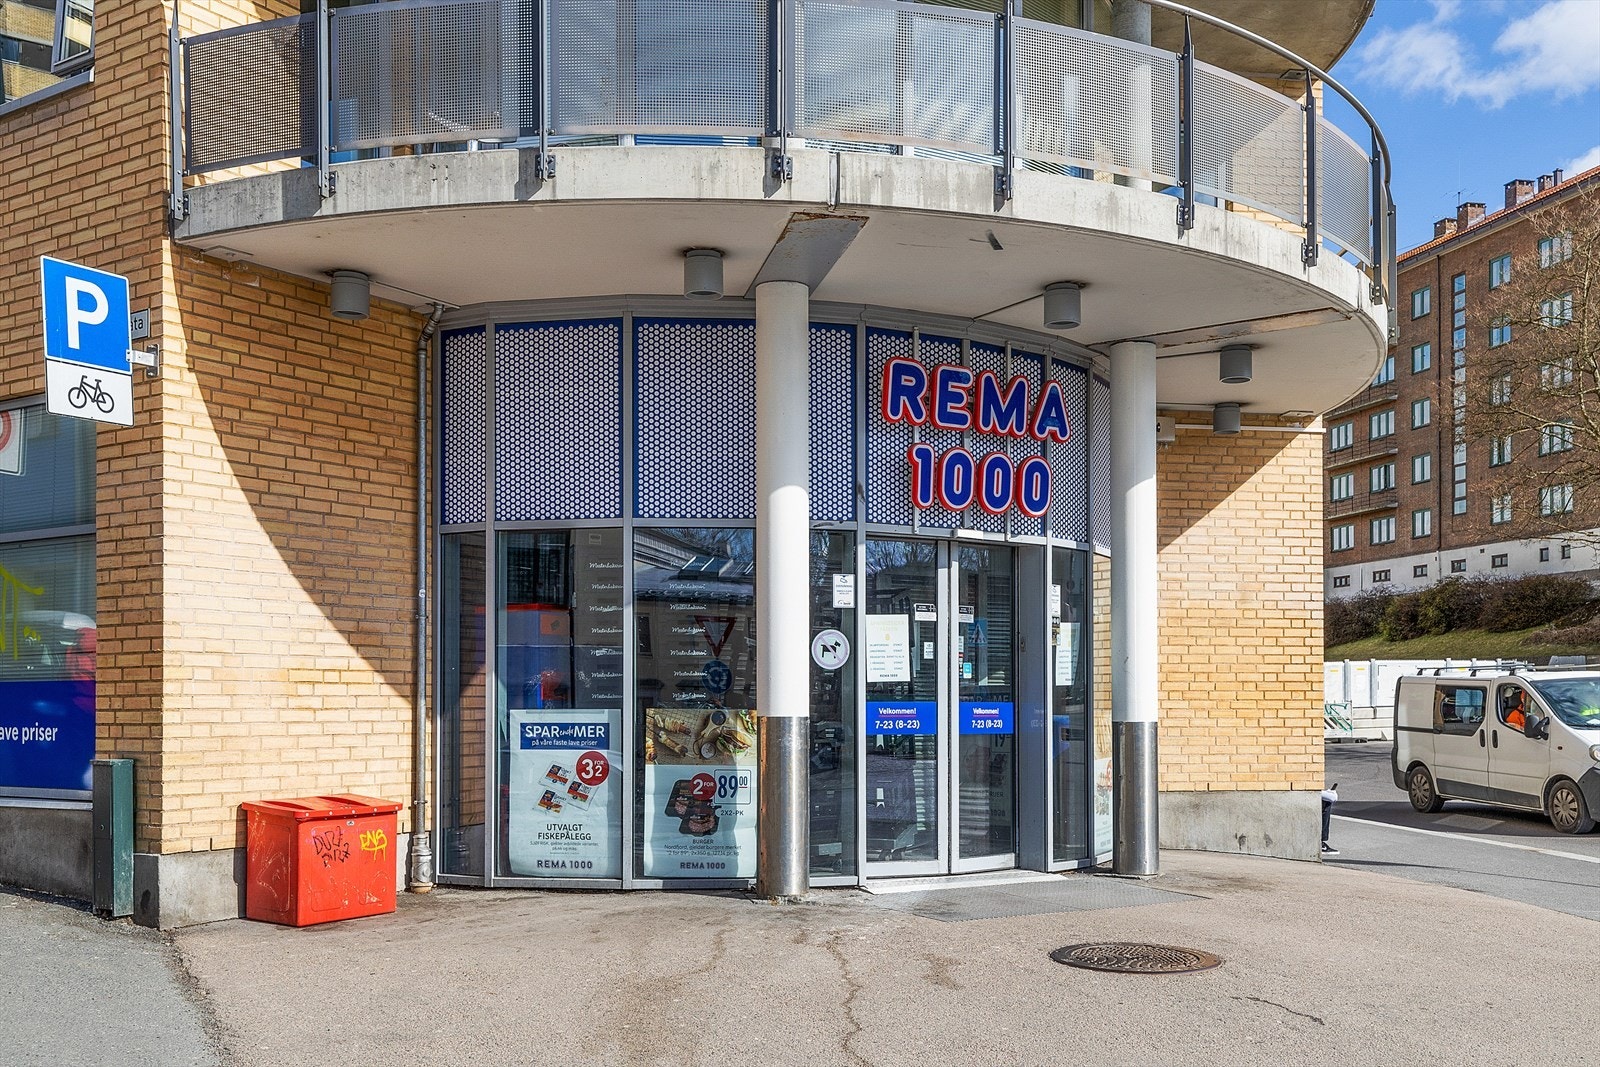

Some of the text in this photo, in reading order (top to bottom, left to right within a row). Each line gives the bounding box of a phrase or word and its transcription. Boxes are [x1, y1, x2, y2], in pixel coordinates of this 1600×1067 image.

[65, 276, 109, 350] P
[882, 356, 1071, 443] REMA
[907, 443, 1052, 517] 1000
[875, 720, 920, 729] 7-23 (8-23)
[971, 719, 1003, 728] 7-23 (8-23)
[22, 722, 59, 744] priser
[525, 725, 559, 737] SPAR
[574, 725, 605, 737] MER
[531, 738, 539, 746] på
[540, 738, 552, 746] våre
[581, 739, 598, 747] priser
[581, 758, 594, 779] 3
[595, 765, 602, 777] 2
[693, 779, 704, 795] 2
[718, 775, 748, 799] 89 00
[546, 823, 583, 831] UTVALGT
[537, 830, 592, 841] FISKEPÅLEGG
[537, 860, 593, 869] REMA 1000
